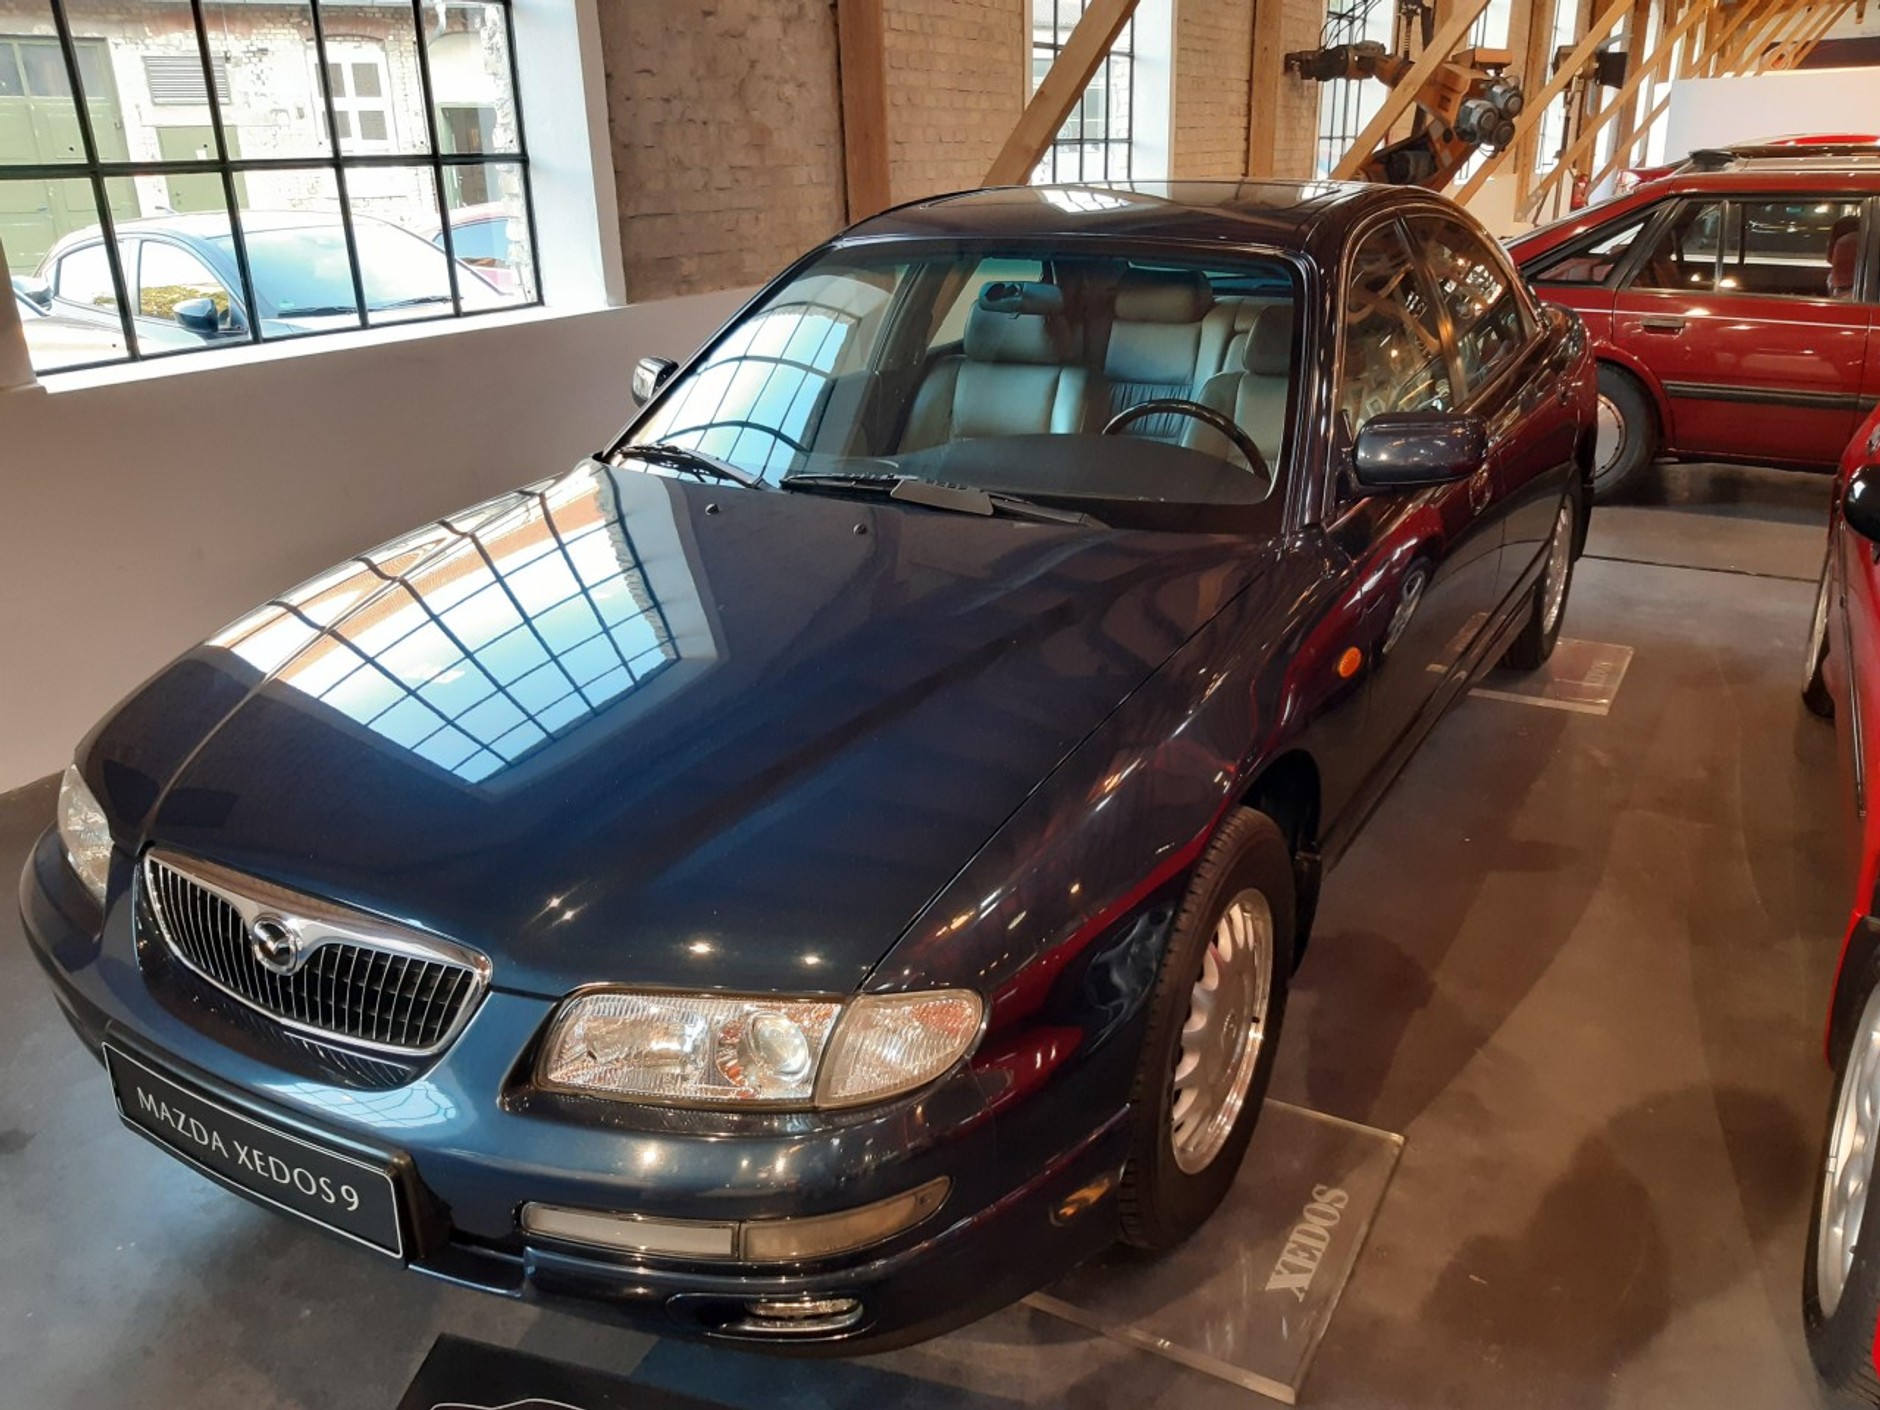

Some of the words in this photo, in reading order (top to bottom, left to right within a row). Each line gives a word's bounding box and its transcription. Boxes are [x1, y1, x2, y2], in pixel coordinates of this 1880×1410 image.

[136, 1087, 228, 1158] MAZDA
[233, 1141, 335, 1203] XEDOS
[340, 1184, 360, 1211] 9
[1265, 1183, 1349, 1302] XEDOS
